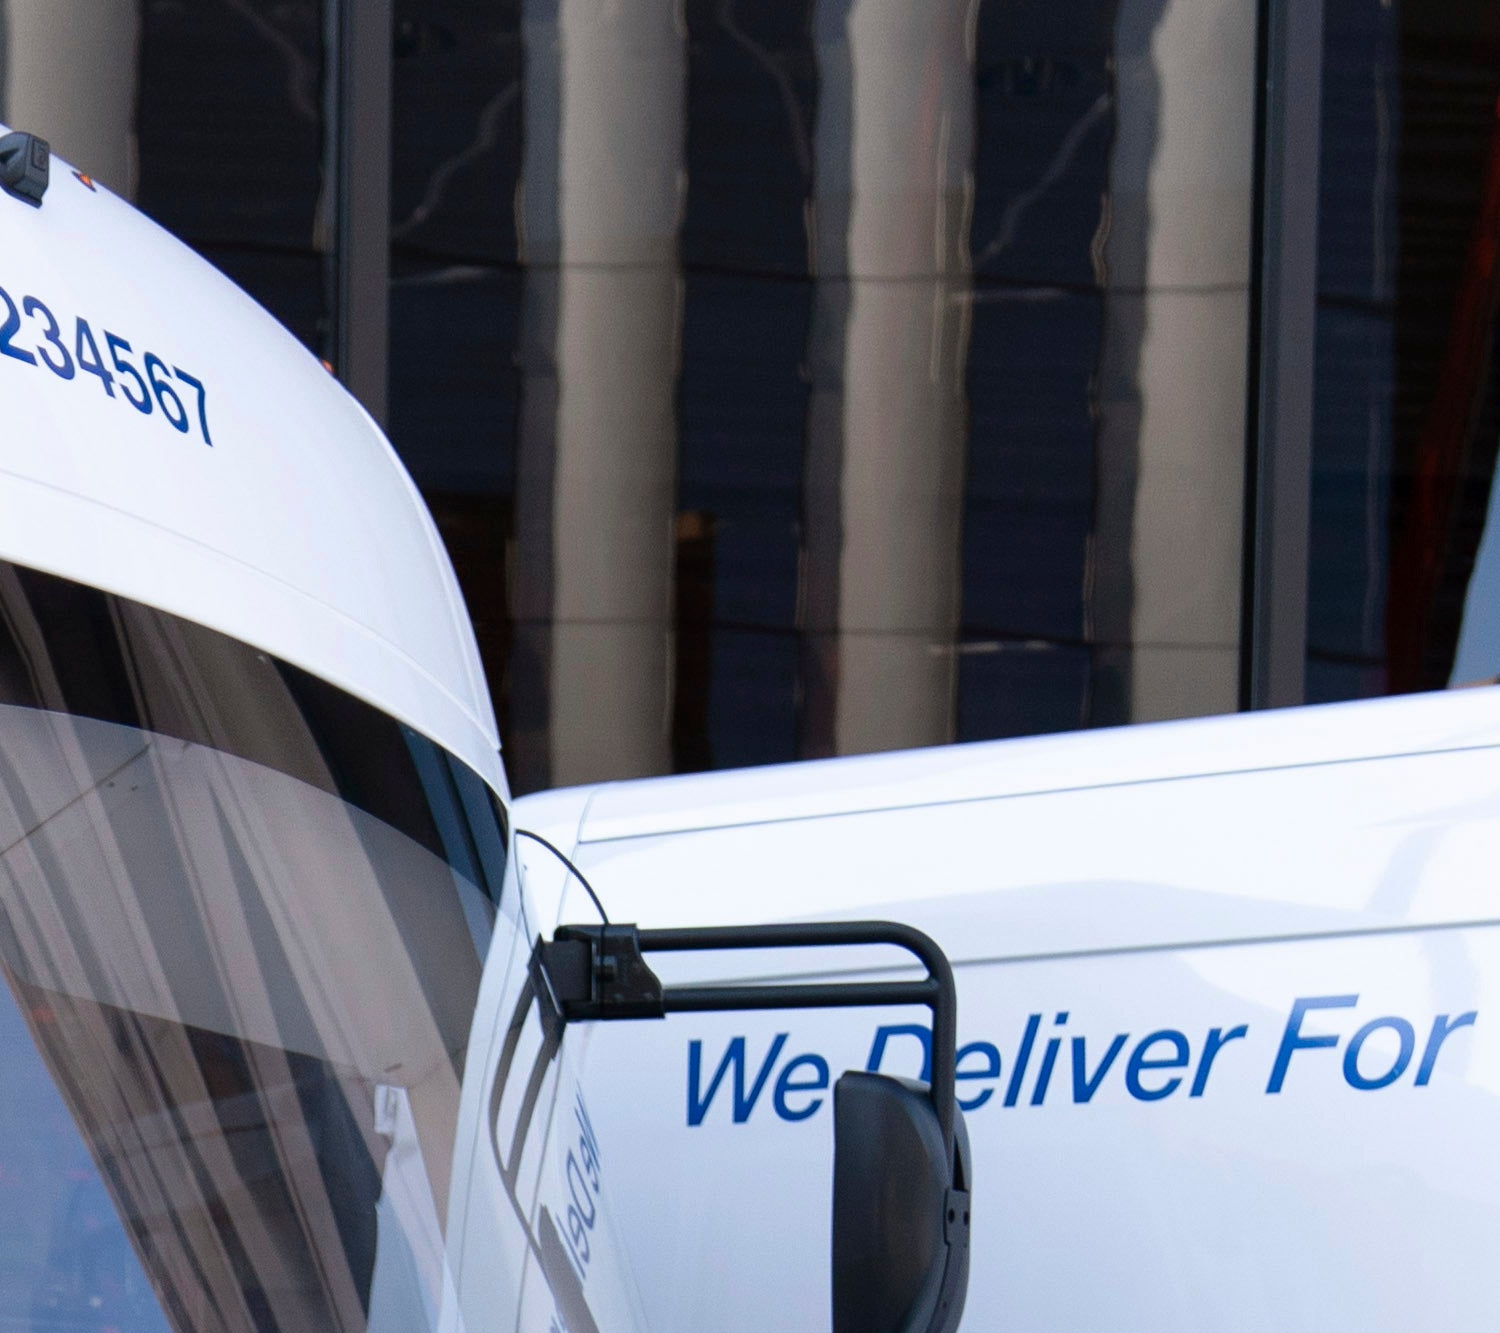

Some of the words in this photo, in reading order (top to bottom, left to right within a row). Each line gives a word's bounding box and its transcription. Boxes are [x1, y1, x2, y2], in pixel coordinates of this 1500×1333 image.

[686, 1032, 830, 1127] We
[866, 1011, 1250, 1111] Deliver
[1265, 994, 1479, 1094] For
